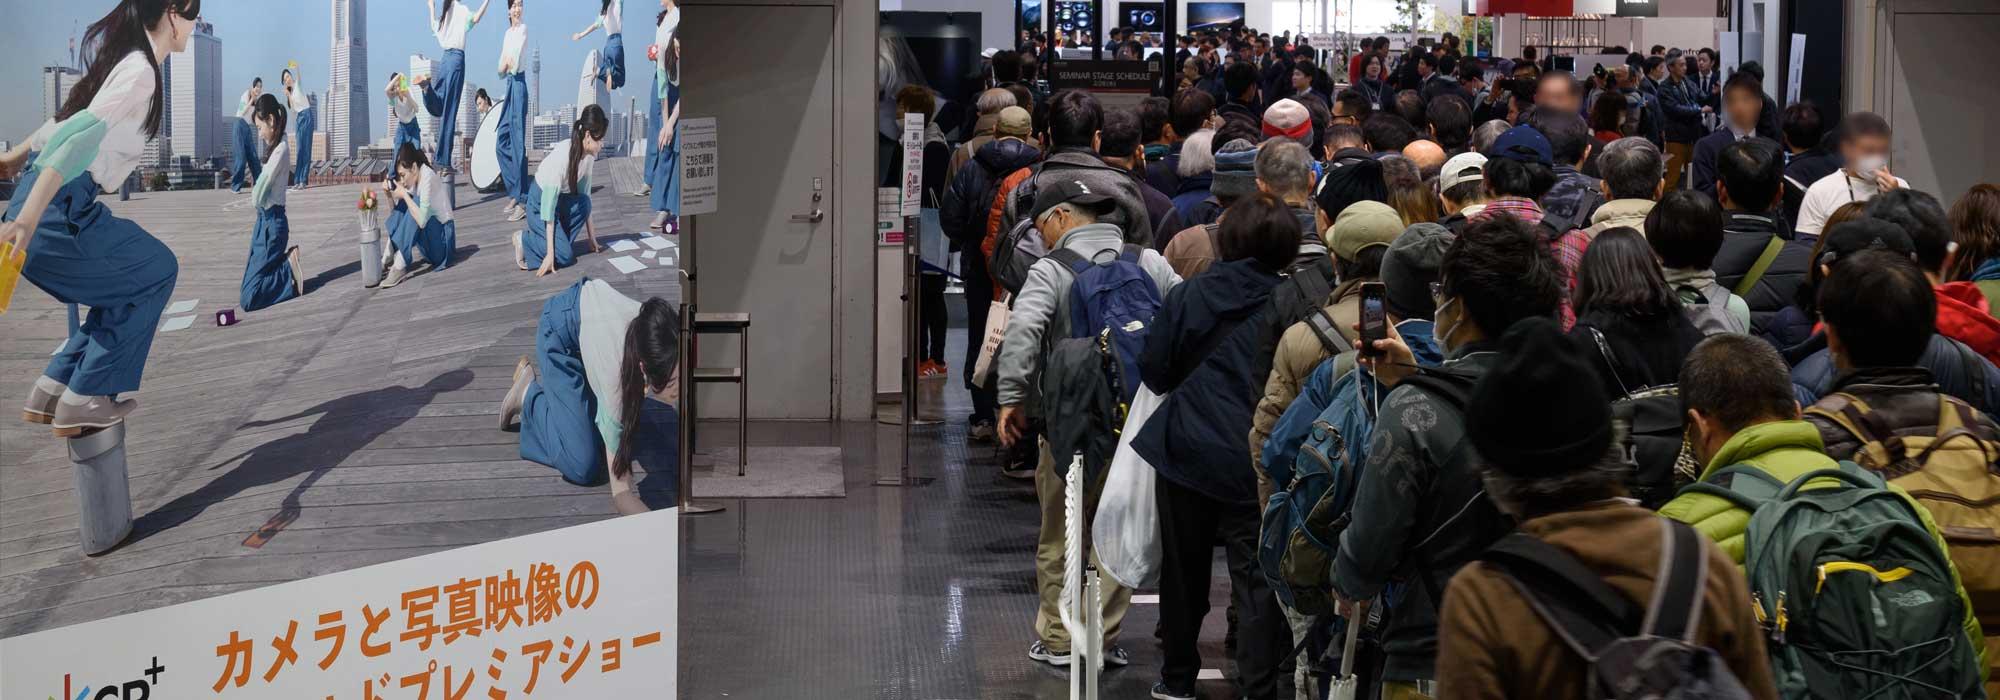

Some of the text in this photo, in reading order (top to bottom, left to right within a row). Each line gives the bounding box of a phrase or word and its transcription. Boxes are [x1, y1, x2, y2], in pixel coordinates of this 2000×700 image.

[1058, 71, 1152, 80] SEMINAR STAGE SCHEDULE
[212, 560, 599, 693] カメラと写真映像の
